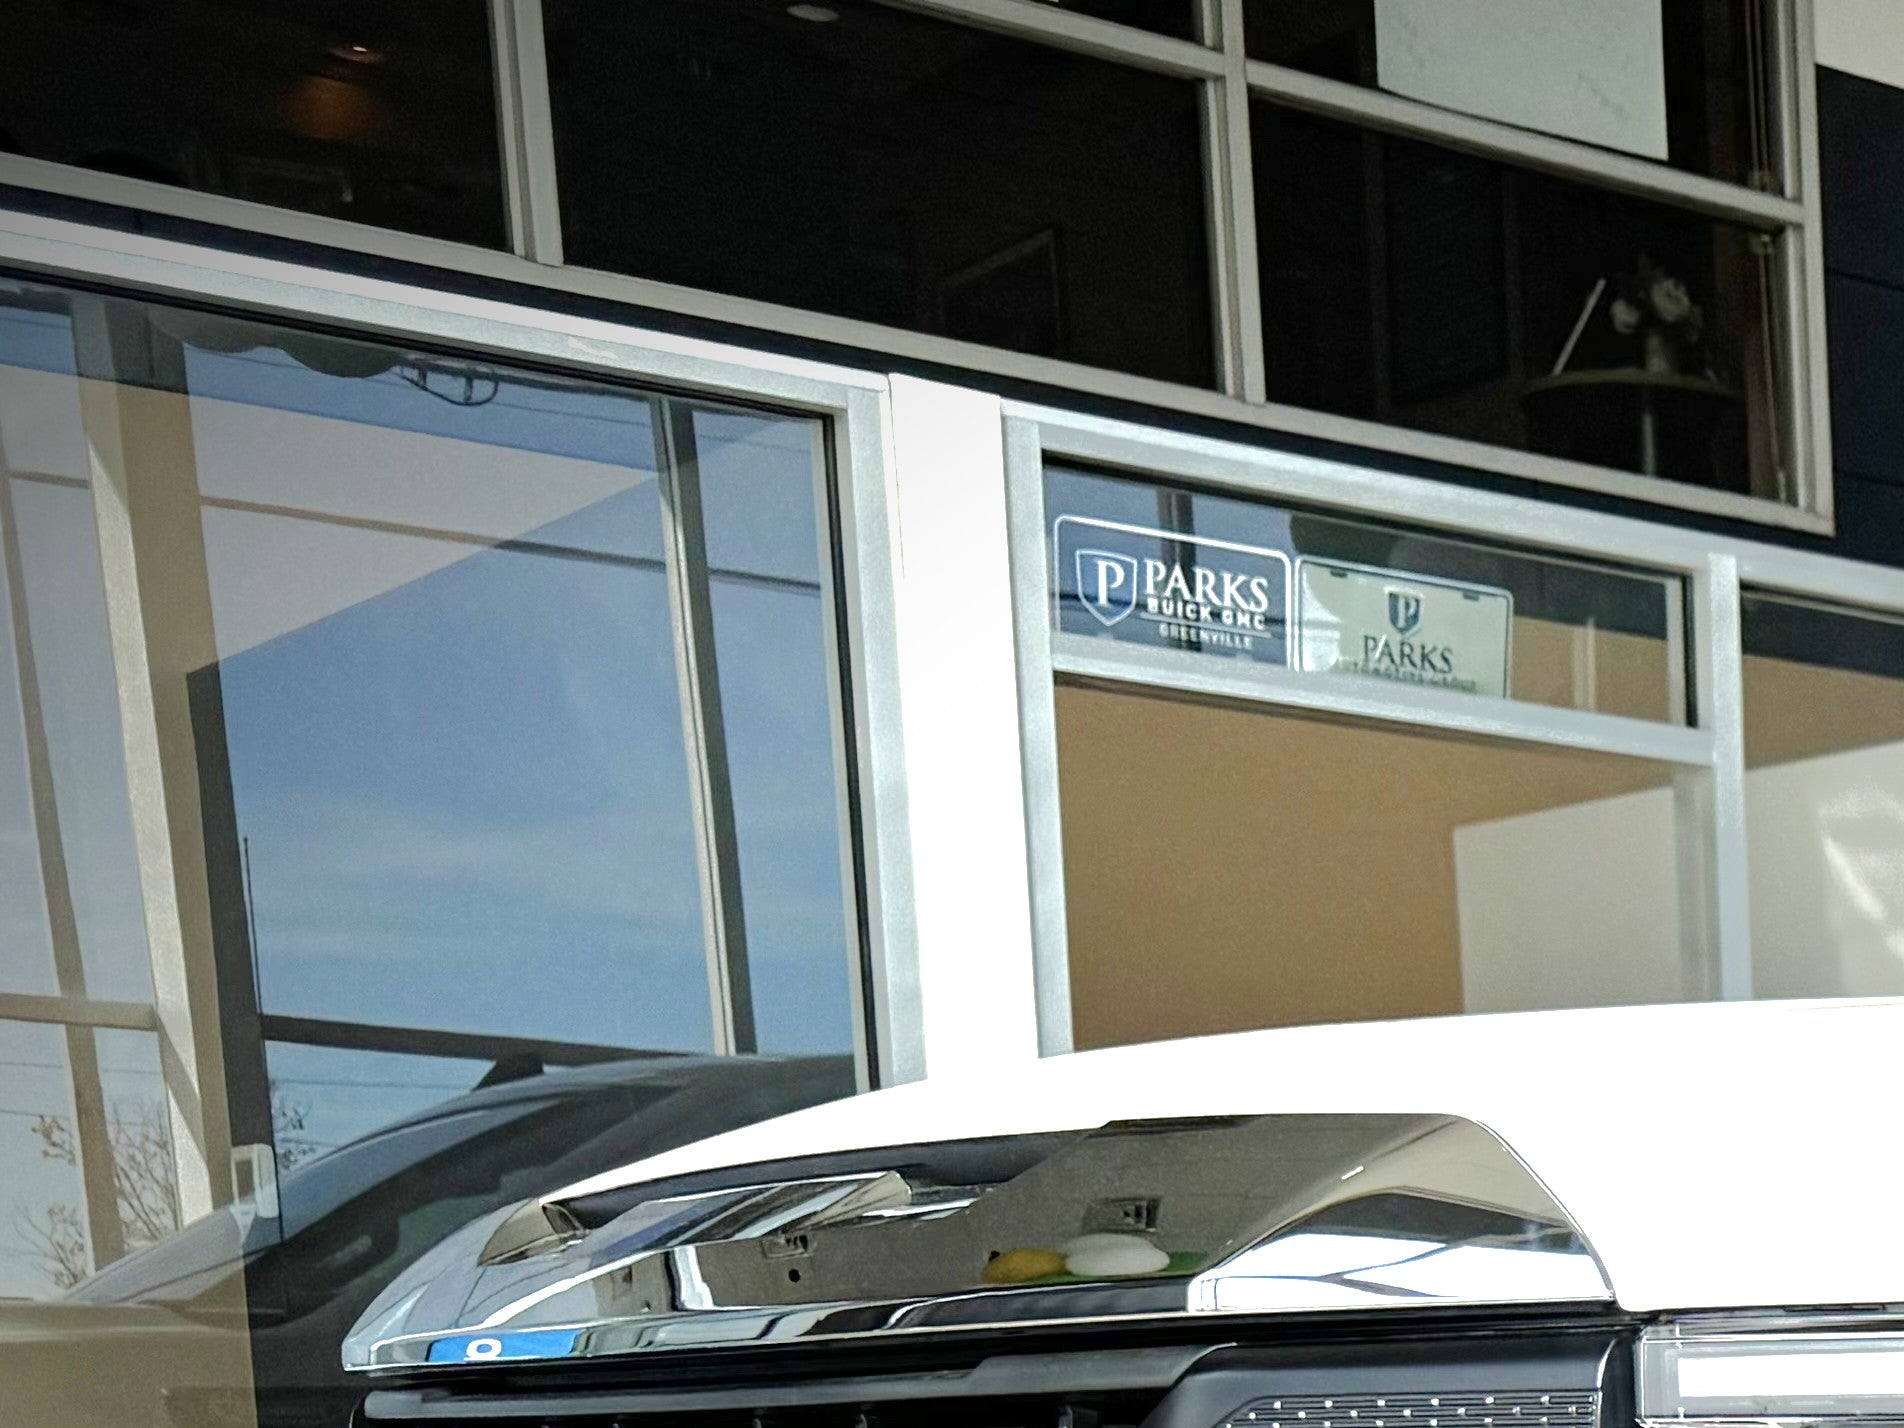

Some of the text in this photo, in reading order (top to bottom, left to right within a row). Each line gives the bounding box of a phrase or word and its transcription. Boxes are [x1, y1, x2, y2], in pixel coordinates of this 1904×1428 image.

[1143, 557, 1269, 614] PARKS
[1146, 597, 1266, 631] BUICK GMC
[1159, 622, 1253, 649] GREENVILLE
[1363, 634, 1454, 674] PARKS
